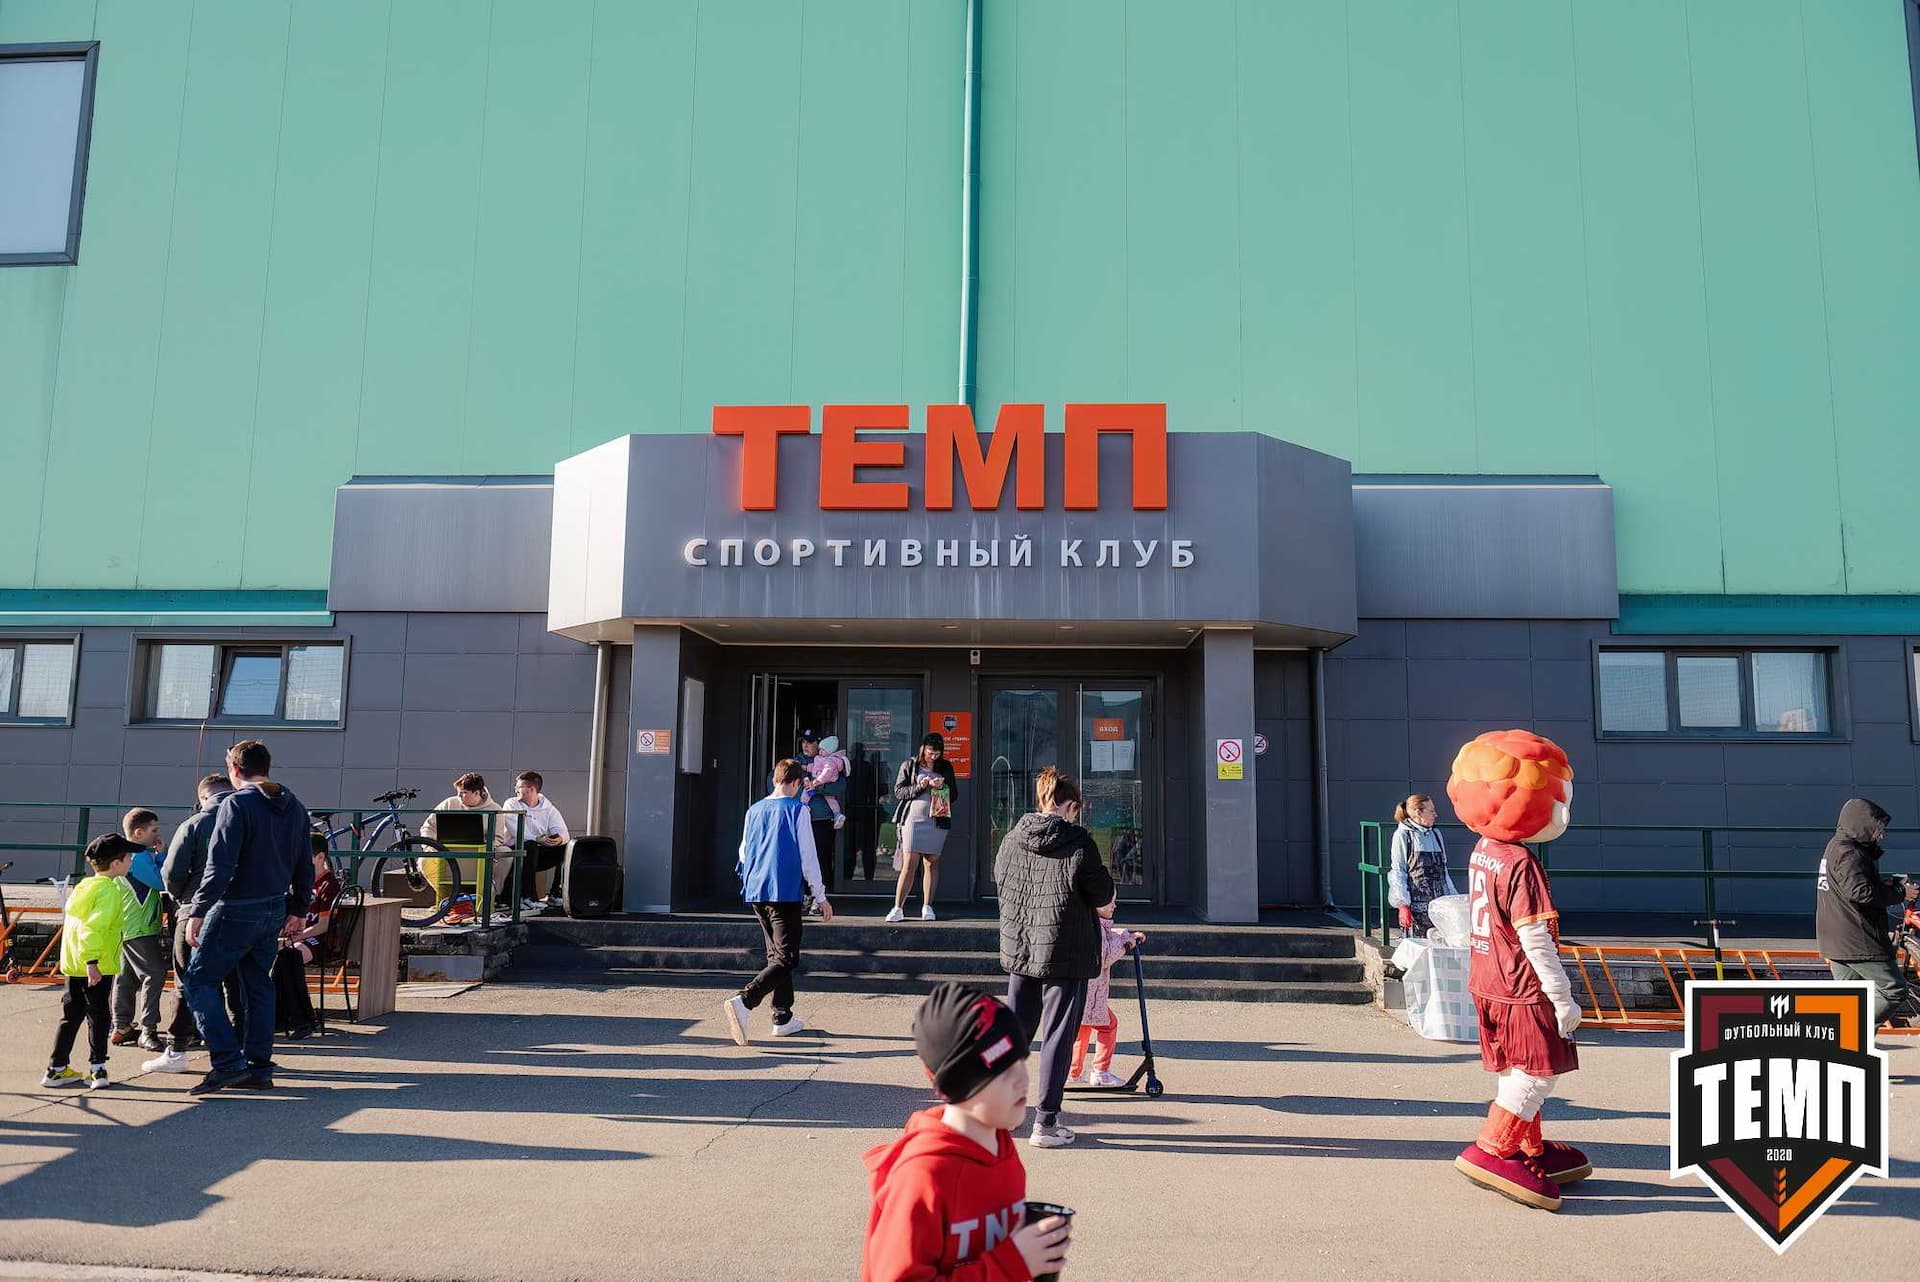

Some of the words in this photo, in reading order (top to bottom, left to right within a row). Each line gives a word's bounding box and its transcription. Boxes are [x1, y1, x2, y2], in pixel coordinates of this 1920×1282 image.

[713, 403, 1167, 511] ТЕМП
[684, 534, 1032, 567] СПОРТИВНЫЙ
[1060, 539, 1194, 568] КЛУБ
[1099, 726, 1119, 734] ВХОД
